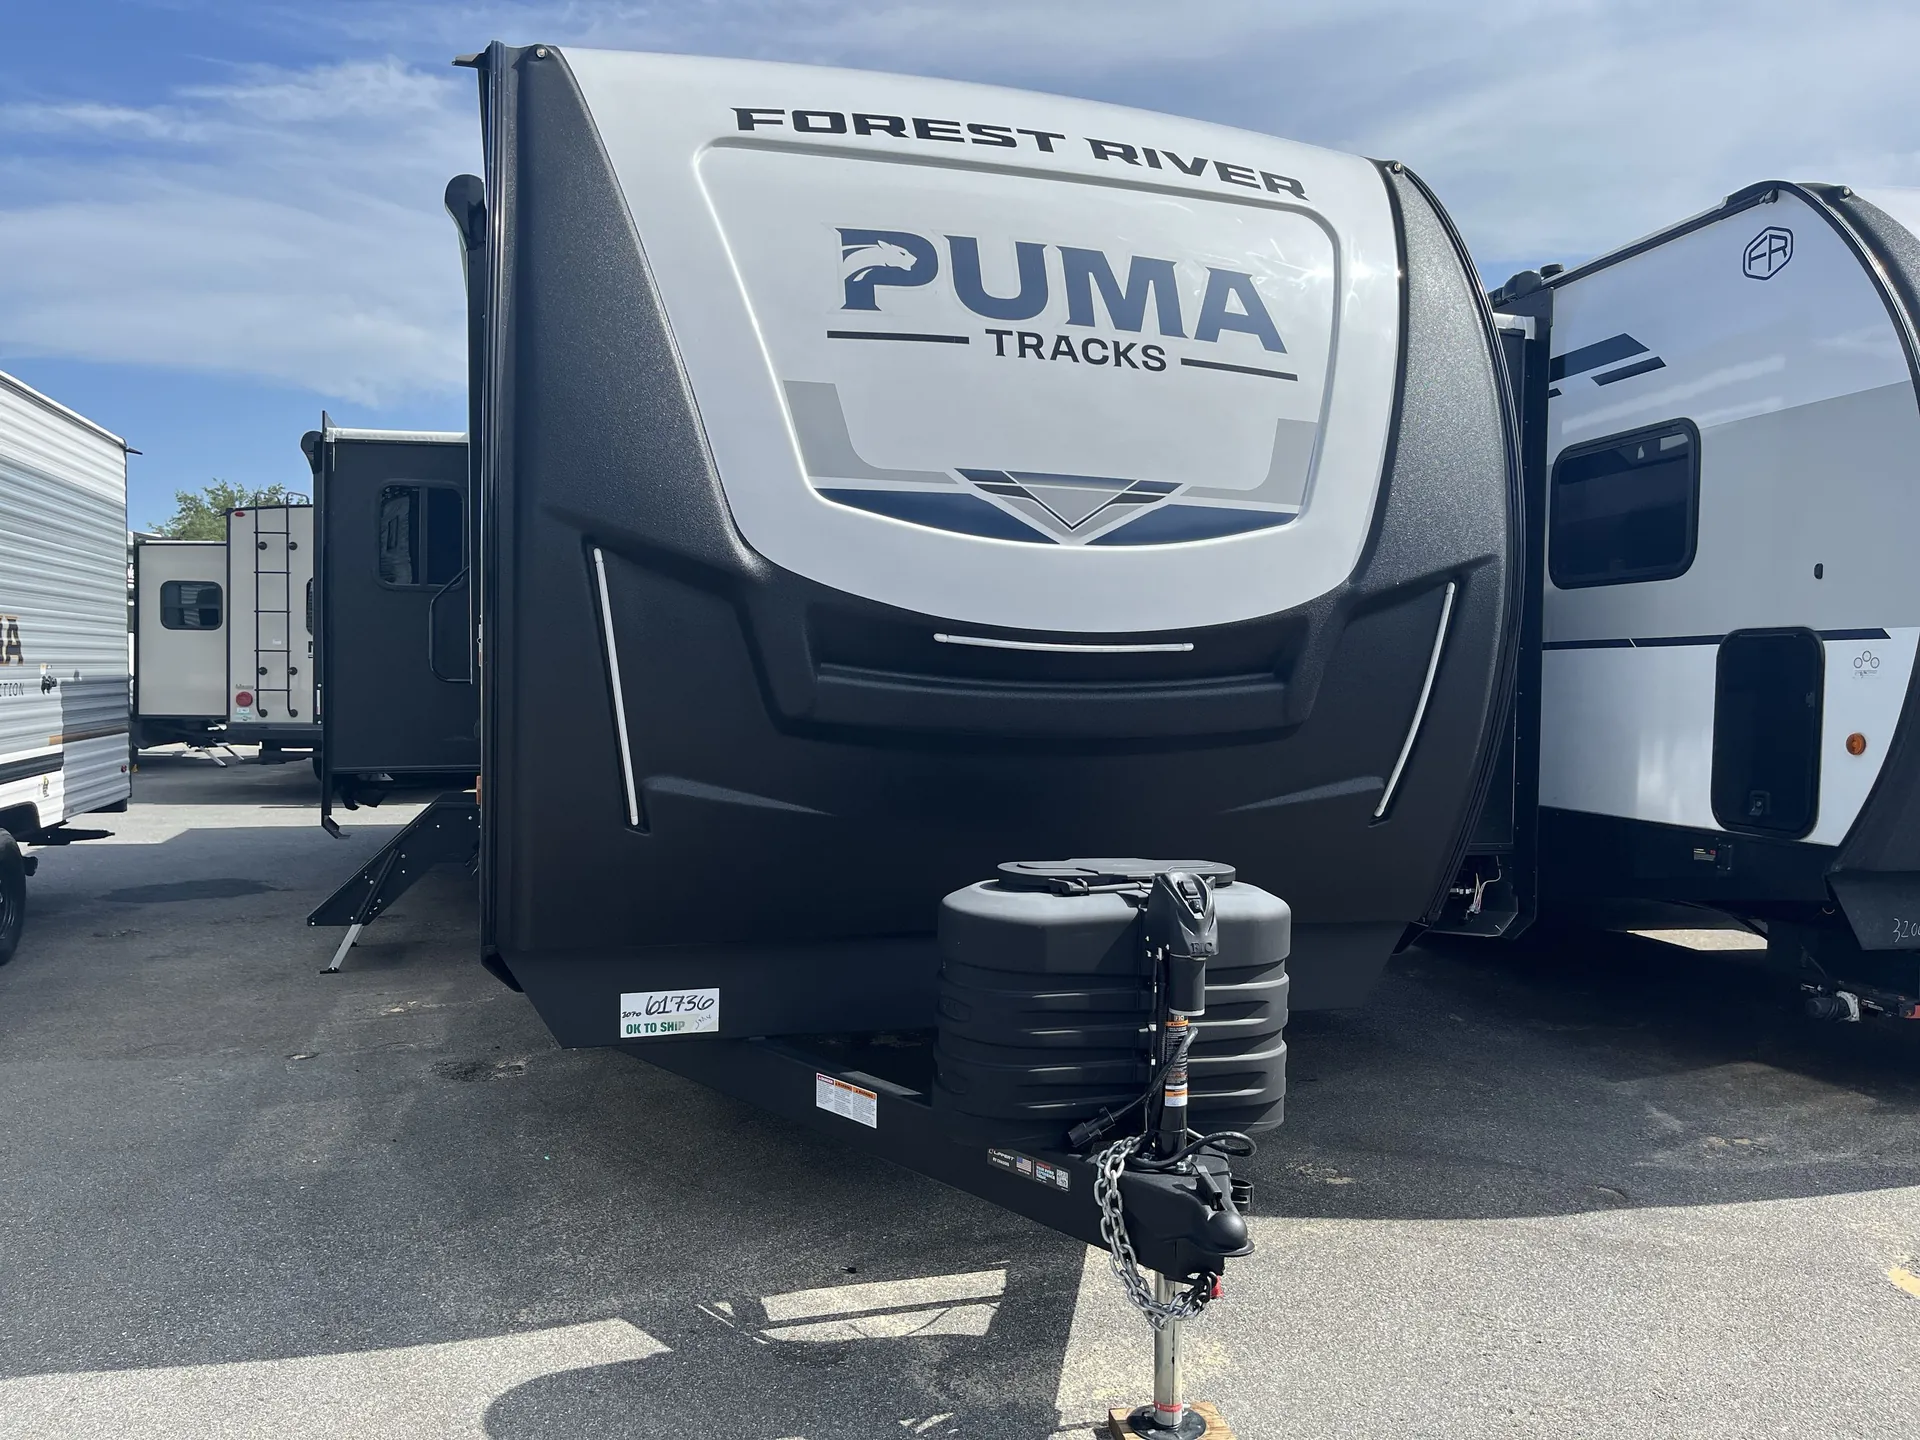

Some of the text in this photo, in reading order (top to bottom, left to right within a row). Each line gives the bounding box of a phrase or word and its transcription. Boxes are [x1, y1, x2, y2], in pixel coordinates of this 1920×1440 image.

[730, 107, 1311, 201] FOREST RIVER
[835, 227, 1288, 355] PUMA
[984, 328, 1168, 372] TRACKS
[0, 615, 24, 666] A
[0, 682, 25, 697] TION
[625, 1023, 641, 1034] OK
[644, 1022, 657, 1033] TO
[660, 1020, 686, 1032] SHIP
[645, 994, 715, 1016] 61736
